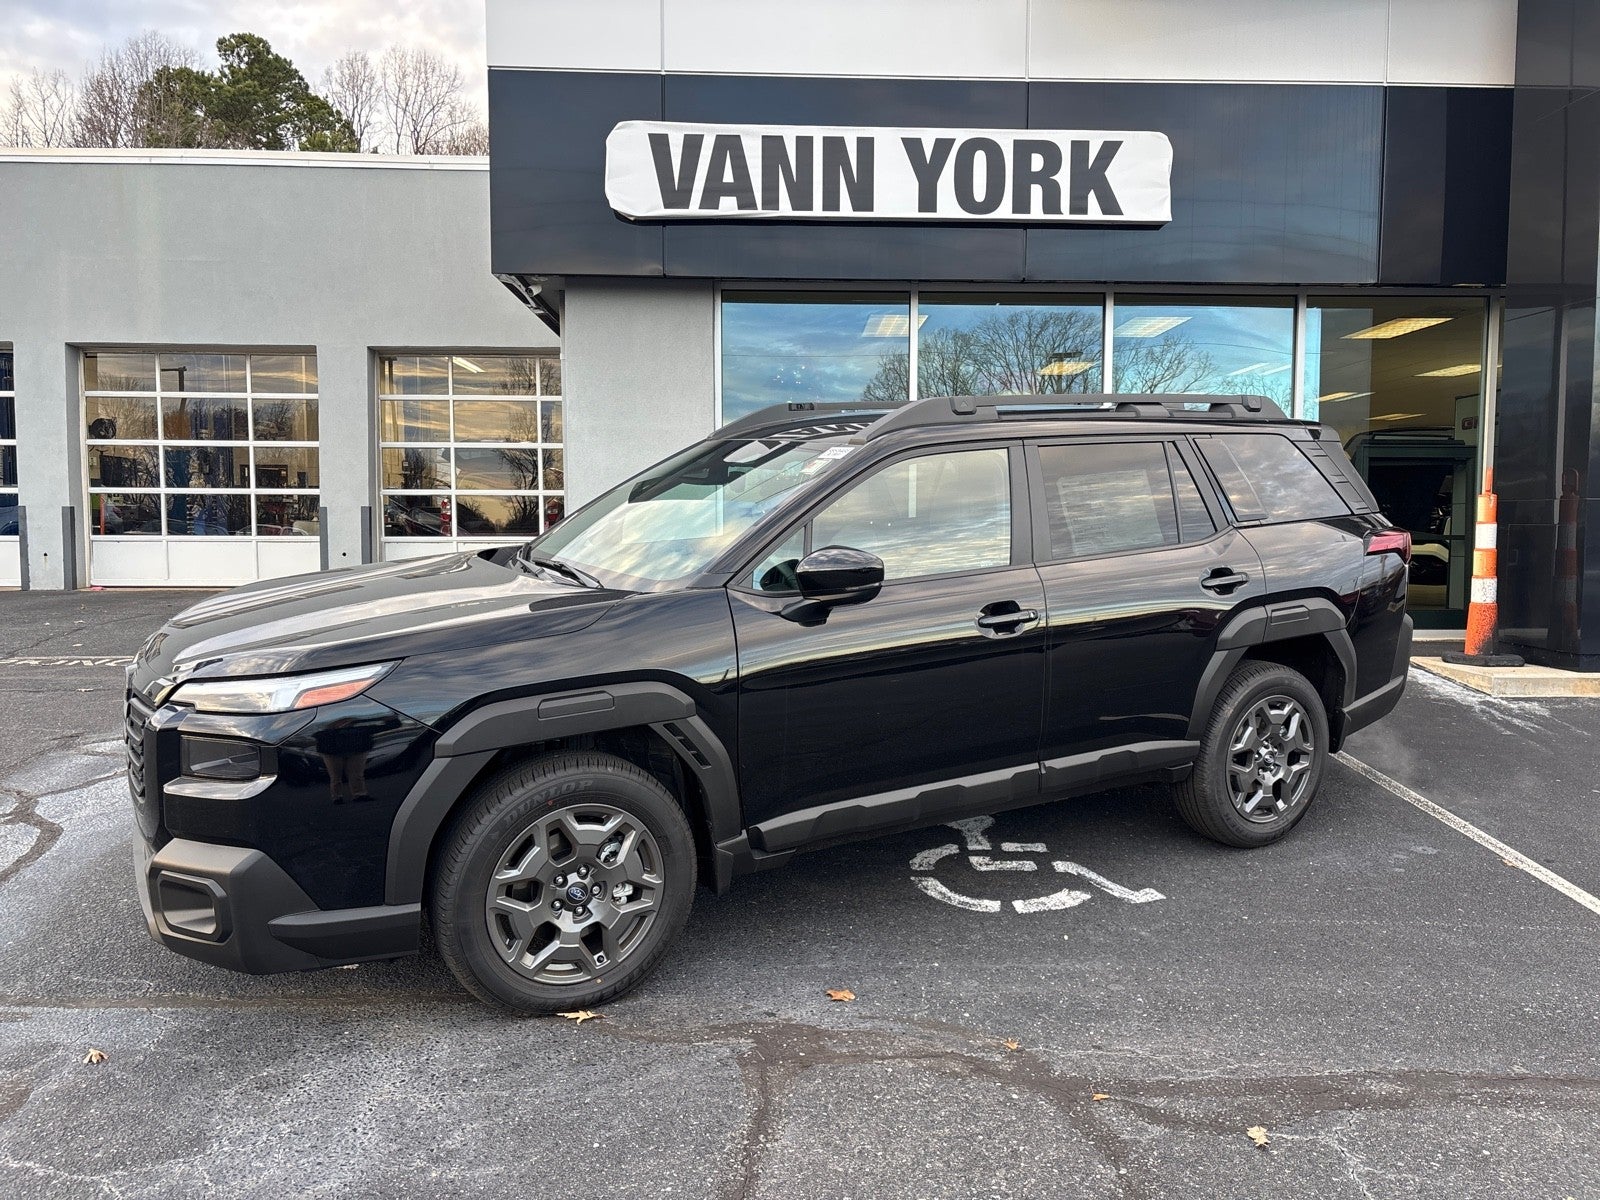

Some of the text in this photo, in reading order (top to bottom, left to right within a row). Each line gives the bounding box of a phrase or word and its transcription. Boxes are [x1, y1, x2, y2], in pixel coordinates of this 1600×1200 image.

[648, 133, 1124, 216] VANN YORK
[503, 780, 594, 826] DUNLOP
